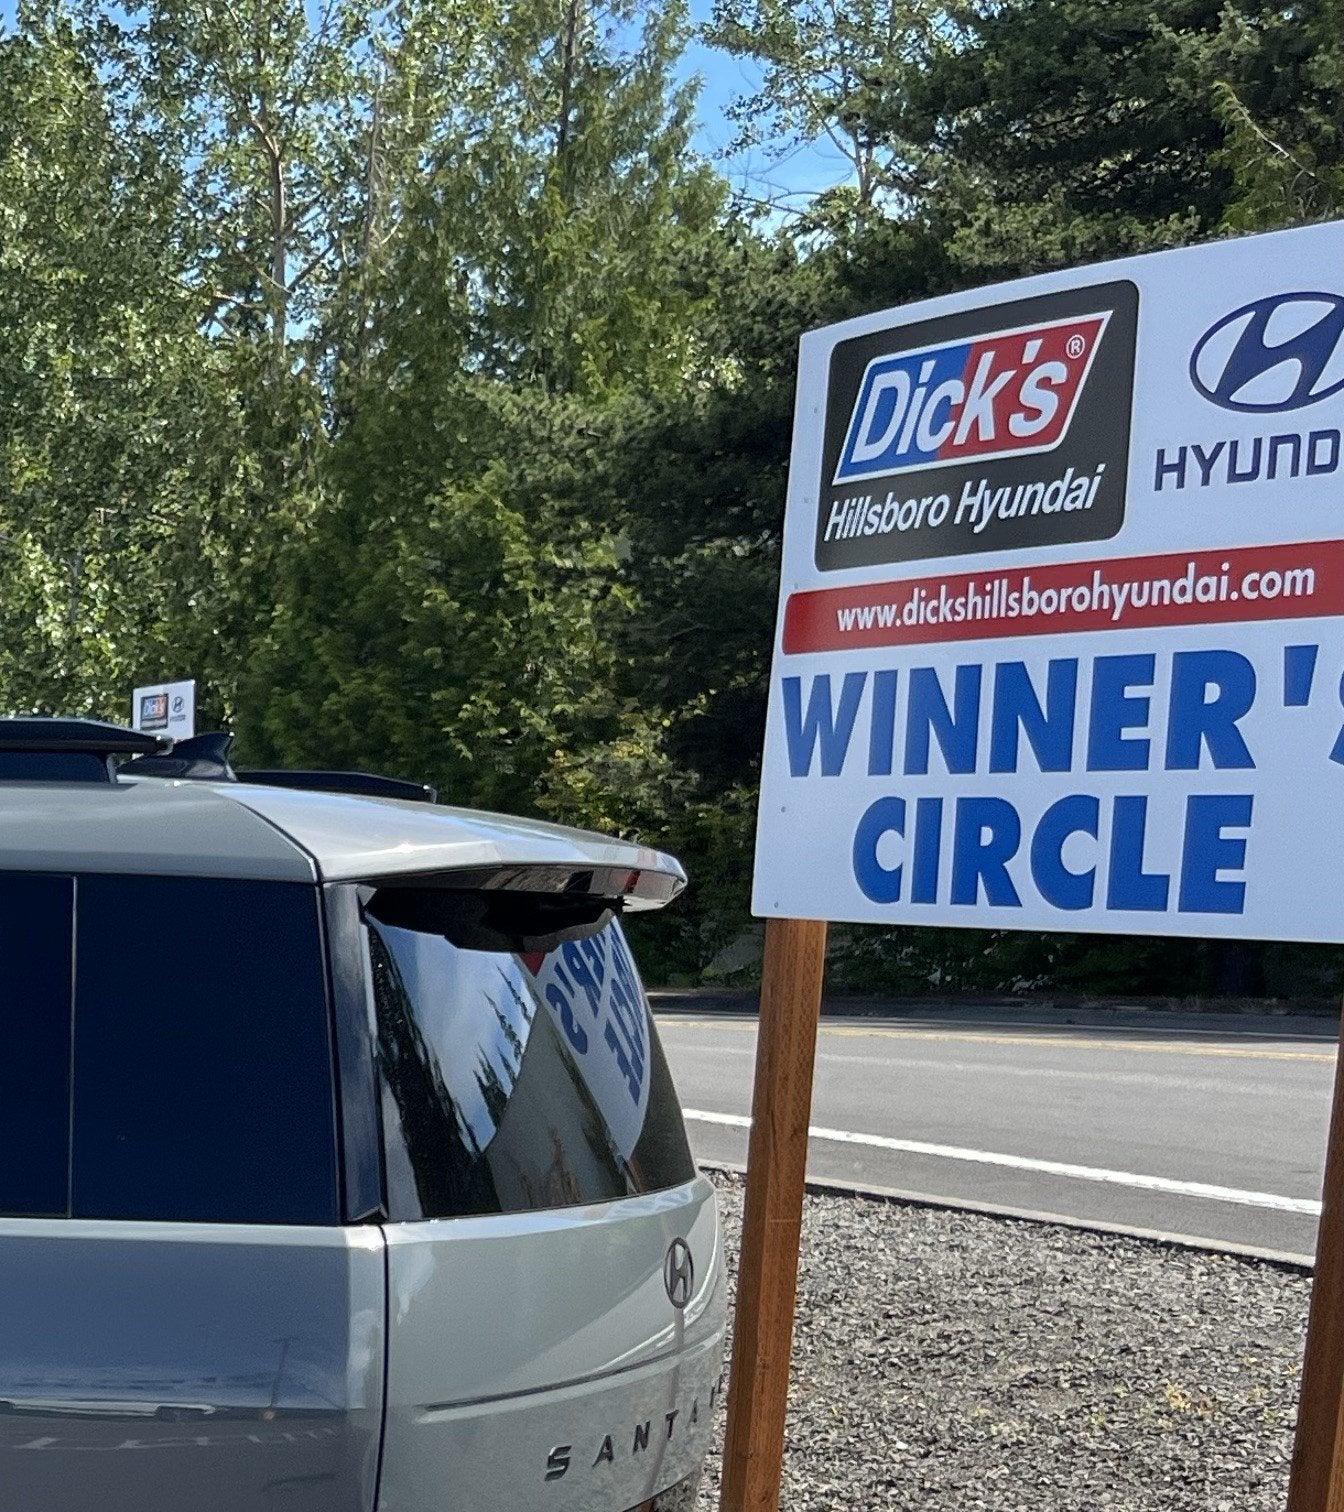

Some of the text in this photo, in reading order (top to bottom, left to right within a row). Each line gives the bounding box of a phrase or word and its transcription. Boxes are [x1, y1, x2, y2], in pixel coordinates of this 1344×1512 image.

[849, 338, 1069, 464] Dick's
[823, 463, 1107, 542] Hillsboro Hyundai
[836, 561, 1315, 632] www.dickshillsborohyundai.com
[781, 645, 1344, 778] WINNER'
[852, 794, 1255, 915] CIRCLE
